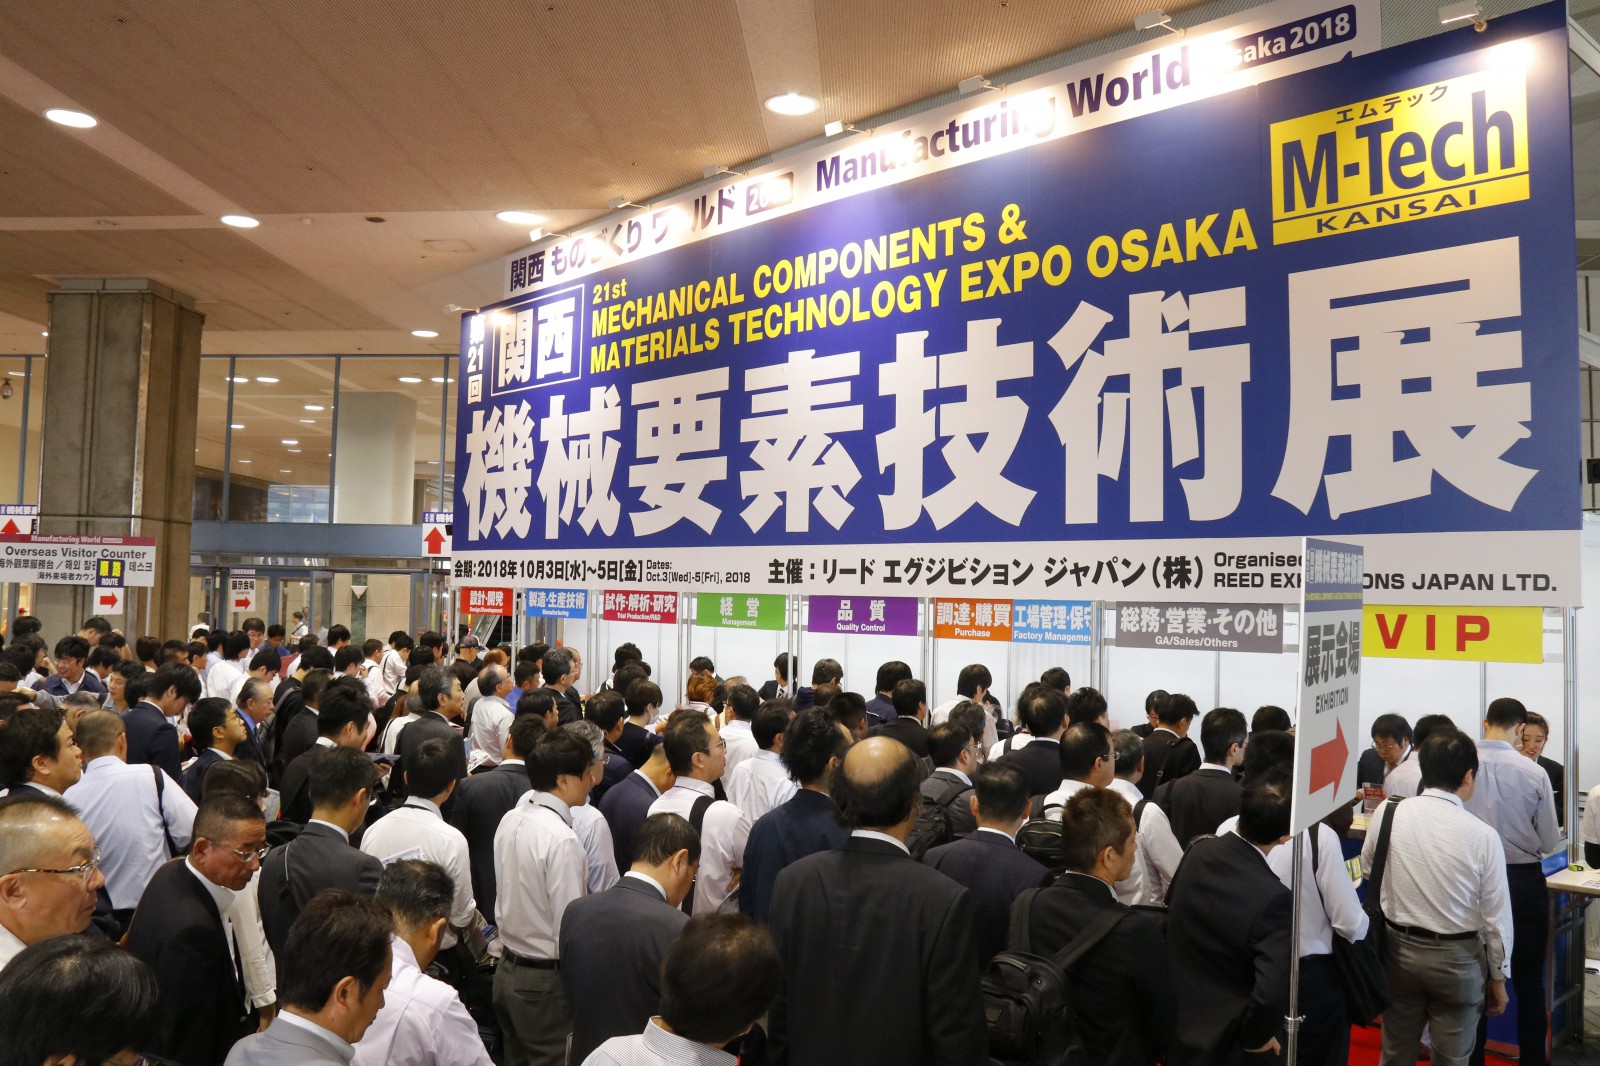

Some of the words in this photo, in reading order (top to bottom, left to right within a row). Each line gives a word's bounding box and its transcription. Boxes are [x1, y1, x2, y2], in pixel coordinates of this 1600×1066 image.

[1336, 85, 1448, 124] エムテック
[510, 251, 545, 292] 関西
[1067, 47, 1191, 118] World
[1290, 12, 1351, 51] 2018
[1281, 90, 1516, 213] M-Tech
[1316, 189, 1477, 234] KANSAI
[592, 273, 745, 338] MECHANICAL
[753, 212, 986, 299] COMPONENTS
[998, 203, 1028, 245] &
[590, 317, 720, 374] MATERIALS
[728, 269, 948, 345] TECHNOLOGY
[961, 244, 1072, 303] EXPO
[1086, 207, 1259, 279] OSAKA
[592, 278, 627, 305] 21st
[498, 297, 576, 388] 関西
[462, 235, 1540, 542] 機械要素技術展
[5, 546, 57, 556] Overseas
[61, 547, 97, 557] Visitor
[101, 549, 147, 559] Counter
[31, 535, 80, 544] Manufacturing
[646, 559, 673, 570] Dates:
[725, 572, 750, 583] 2018
[883, 556, 1034, 588] エグジビション
[101, 578, 119, 586] ROUTE
[1214, 573, 1265, 588] REED
[1412, 573, 1494, 591] JAPAN
[1502, 573, 1557, 592] LTD.
[627, 613, 661, 621] Production/R&D
[720, 597, 760, 617] 経営
[837, 599, 886, 622] 品質
[937, 602, 1011, 628] 調達・購買
[722, 617, 757, 627] Management
[836, 623, 859, 633] Quality
[861, 623, 886, 632] Control
[954, 627, 991, 638] Purchase
[1121, 605, 1278, 637] 総務・営業・その他
[1375, 613, 1491, 652] VIP
[1014, 631, 1043, 641] Factory
[1155, 636, 1239, 648] GA/Sales/Others
[1304, 620, 1360, 687] 展示会場
[1315, 687, 1349, 715] EXHIBITION
